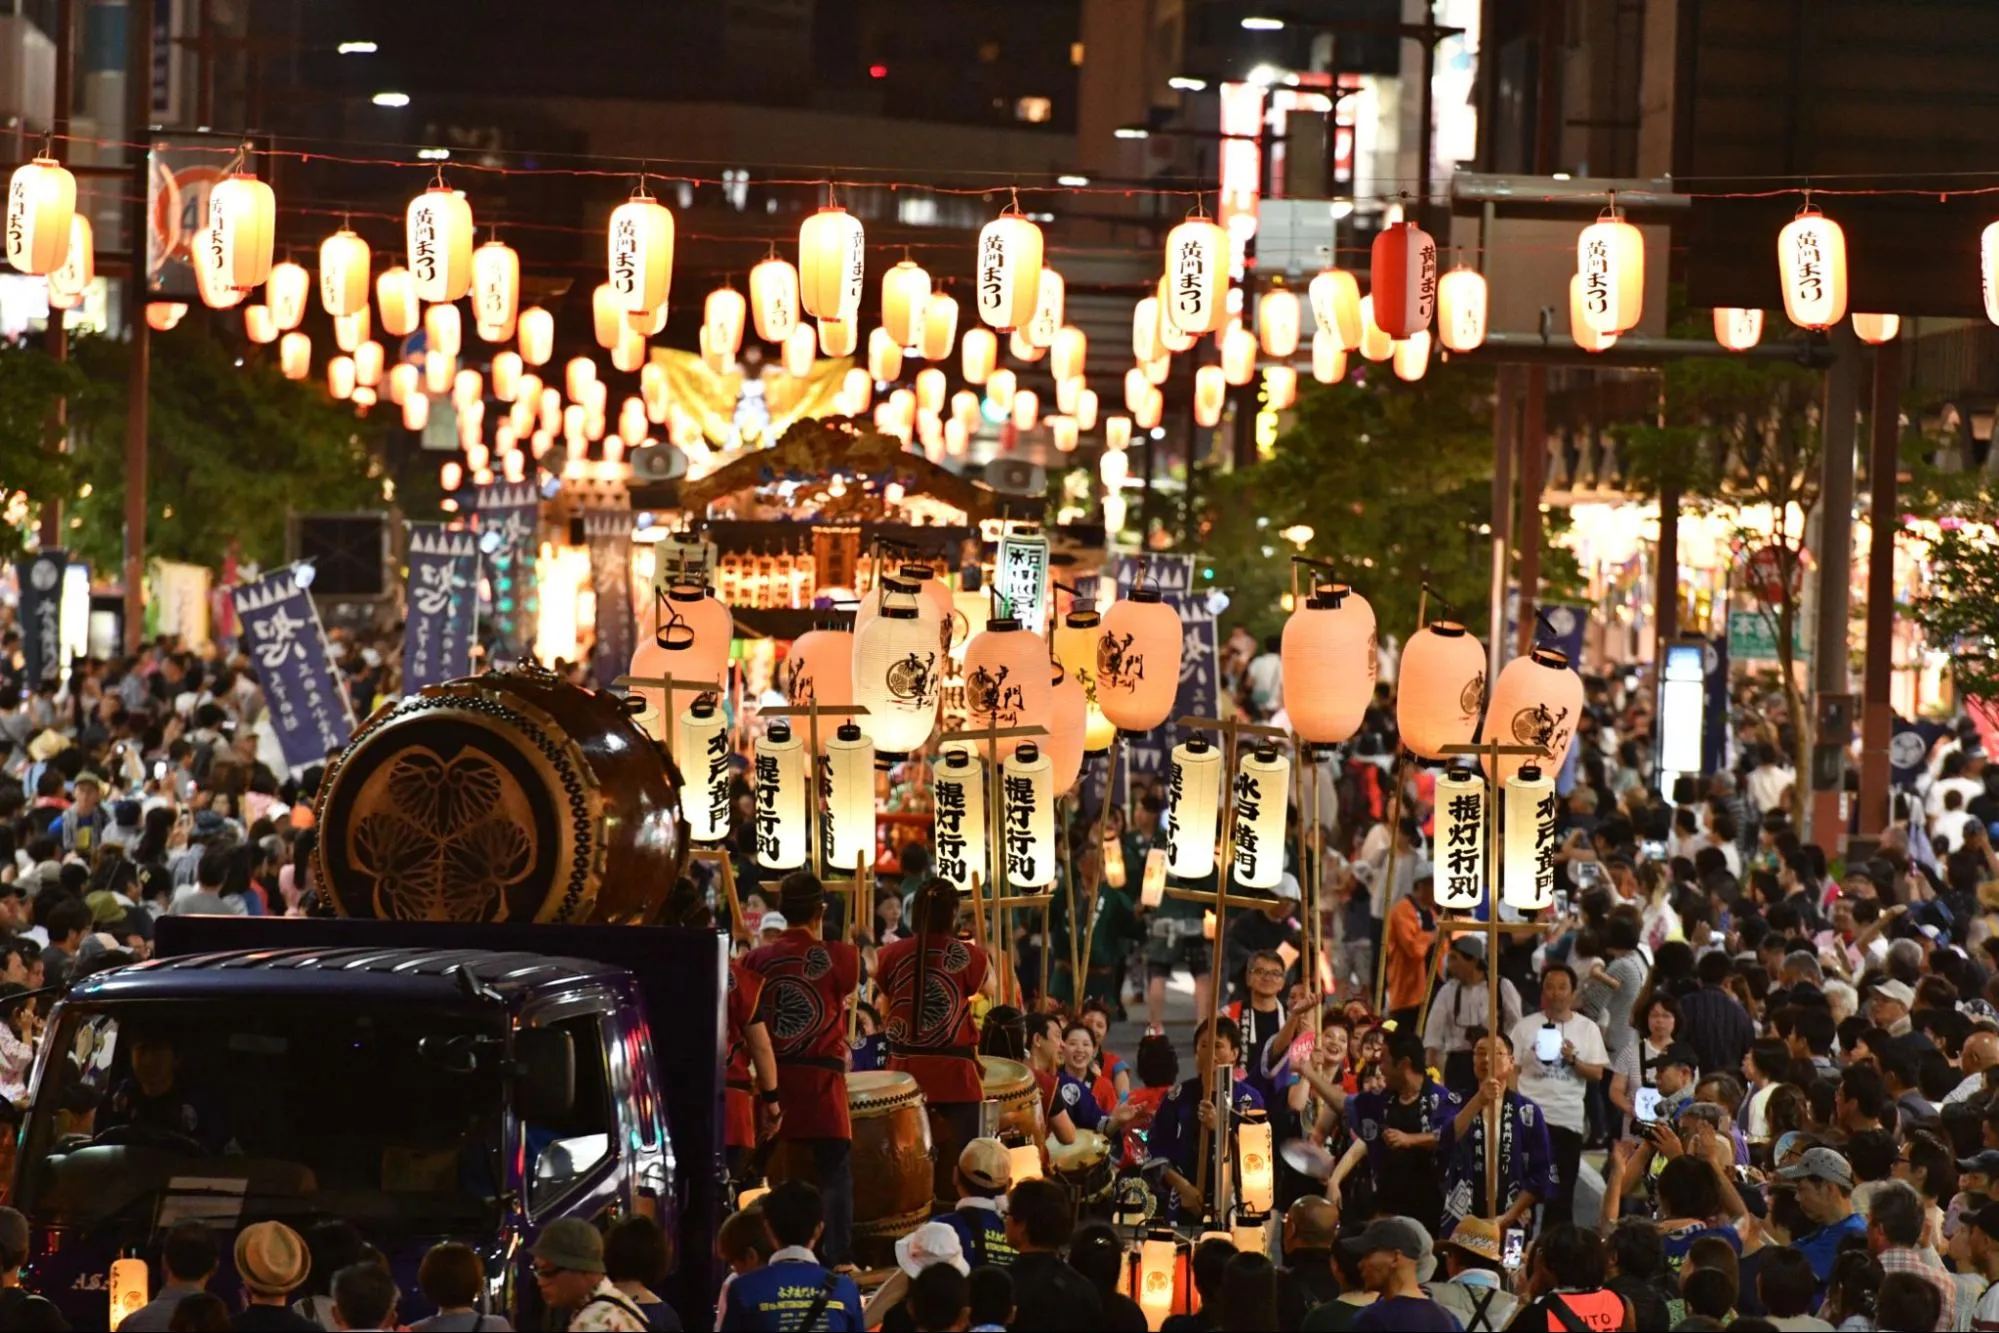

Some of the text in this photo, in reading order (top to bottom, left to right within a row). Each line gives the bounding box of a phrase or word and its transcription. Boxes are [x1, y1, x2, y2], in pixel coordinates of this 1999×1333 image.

[415, 206, 436, 282] 黄門まつり
[614, 218, 636, 294] 黄門まつり
[983, 234, 1005, 309] 黄門まつり
[1179, 240, 1203, 315] 黄門まつり
[1419, 244, 1436, 319] 黄門まつり
[1586, 239, 1608, 314] 黄門まつり
[1797, 229, 1822, 302] 黄門まつり
[755, 754, 781, 861] 提灯行列
[935, 780, 967, 883] 提灯行列
[1005, 775, 1037, 881] 提灯行列
[1234, 772, 1262, 880] 水戸黄門
[1447, 794, 1482, 901] 提灯行列
